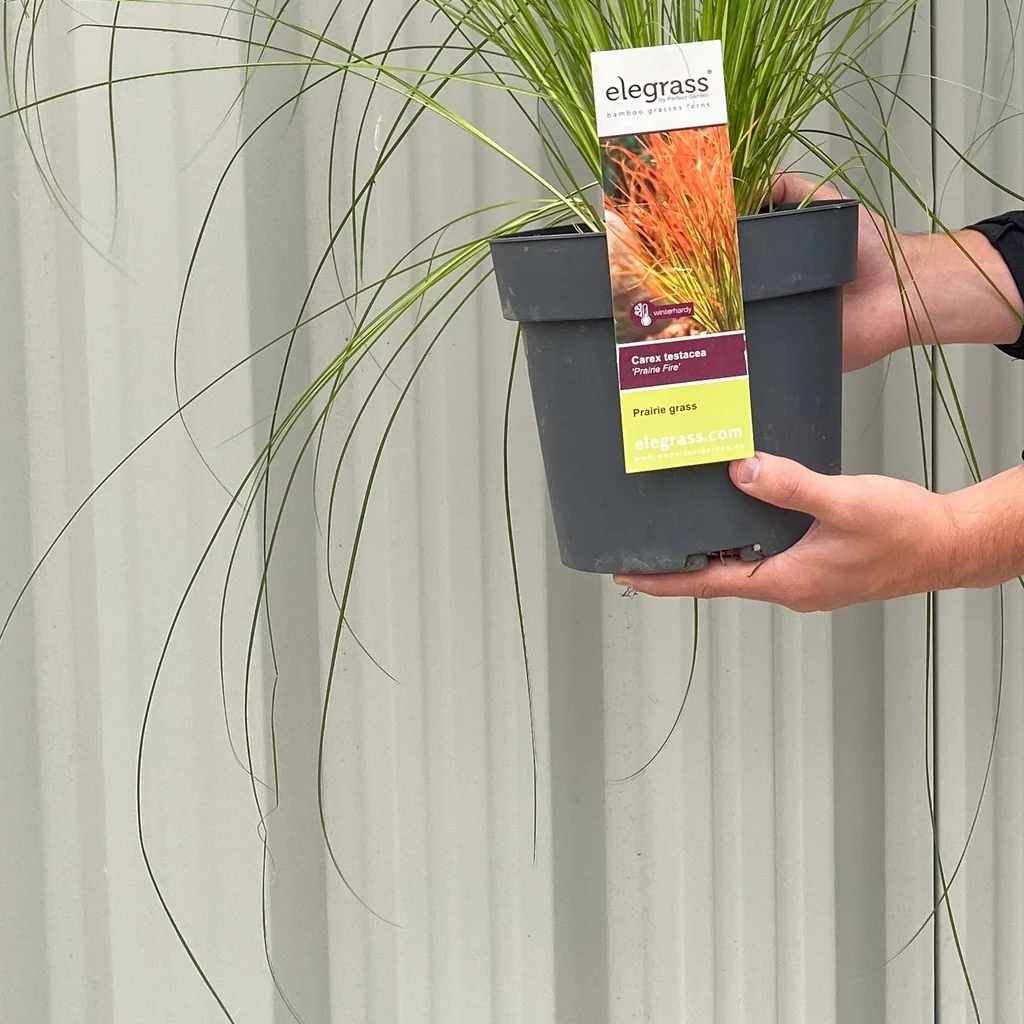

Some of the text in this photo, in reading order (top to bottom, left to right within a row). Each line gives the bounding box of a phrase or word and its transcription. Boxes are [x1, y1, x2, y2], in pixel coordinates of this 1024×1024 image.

[606, 76, 709, 103] elegrass
[607, 102, 711, 118] bamboo grasses ferns
[653, 306, 692, 317] winterhardy
[631, 349, 707, 365] Carex testacea
[633, 403, 697, 417] Prairie grass
[634, 427, 743, 451] elegrass.com
